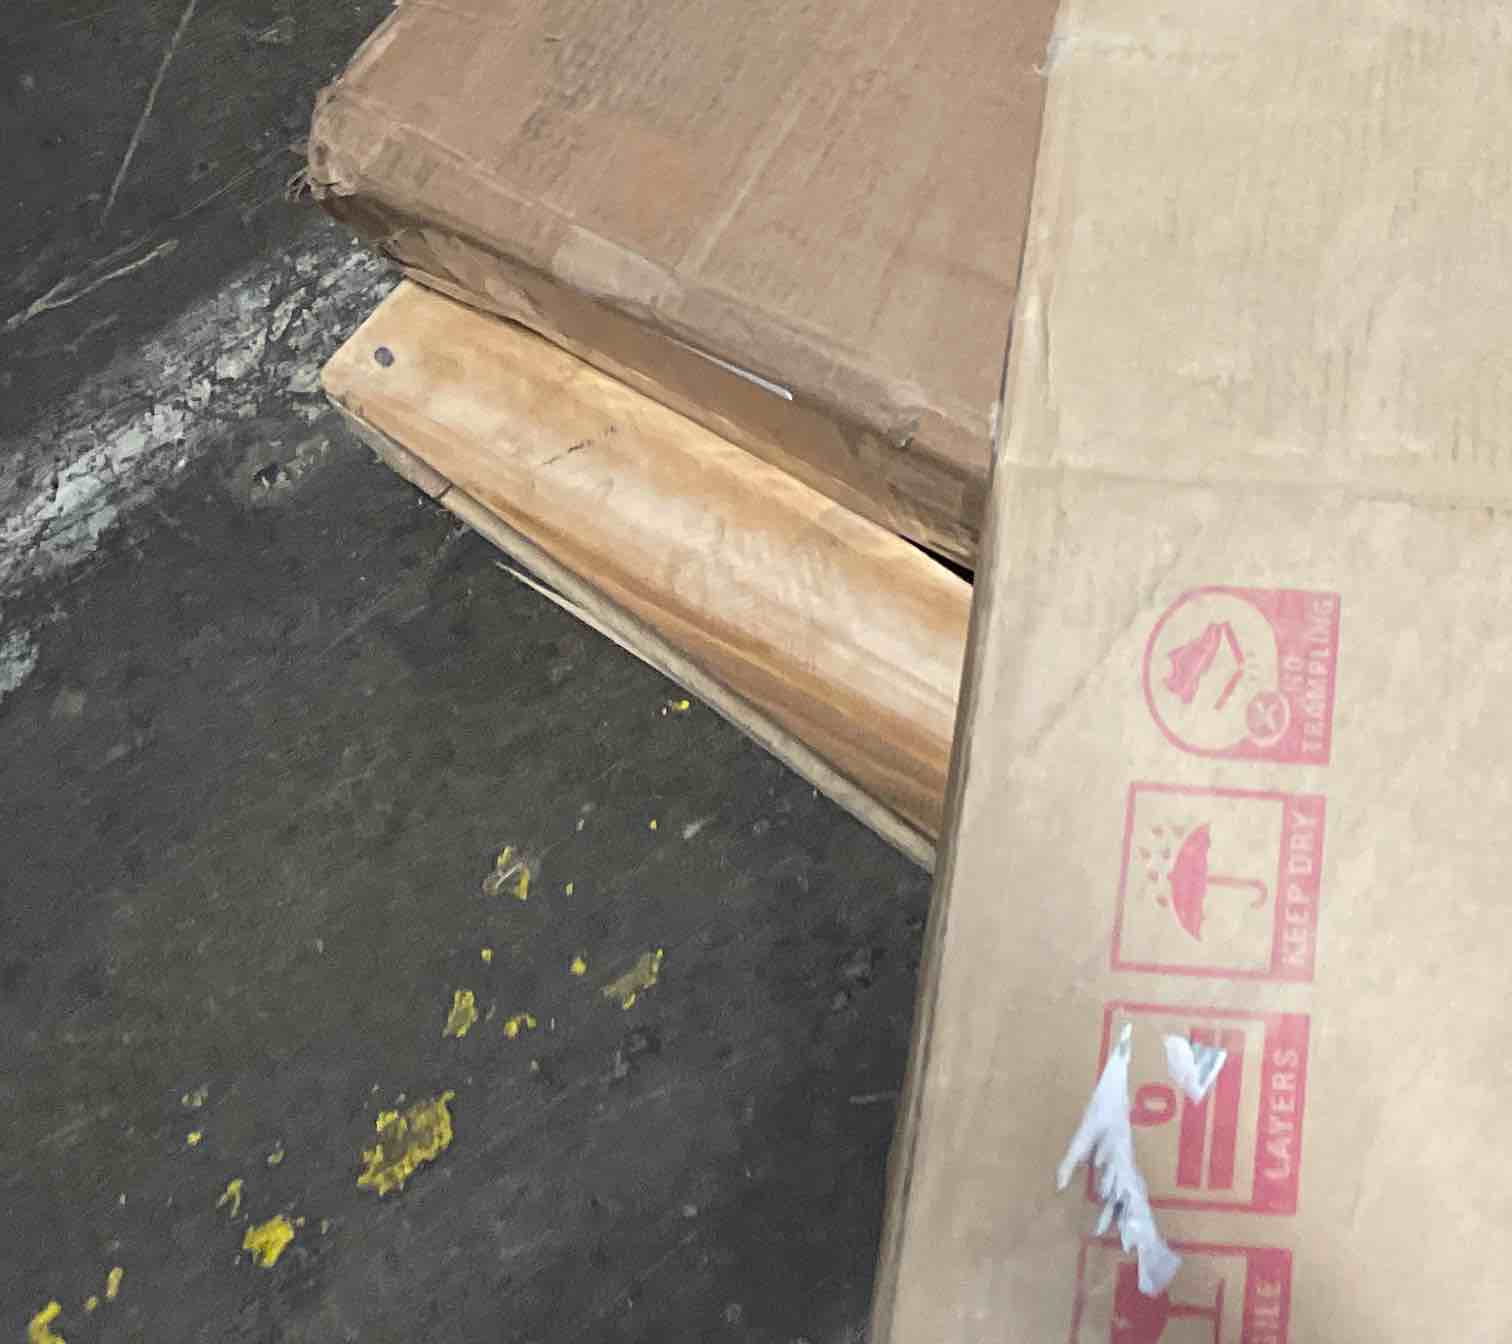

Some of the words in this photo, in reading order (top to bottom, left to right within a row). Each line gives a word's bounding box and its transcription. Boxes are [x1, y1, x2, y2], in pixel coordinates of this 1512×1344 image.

[1302, 596, 1335, 754] TRAMPLING
[1287, 810, 1316, 874] DRY
[1280, 885, 1312, 967] KEEP
[1263, 1047, 1298, 1181] LAYERS
